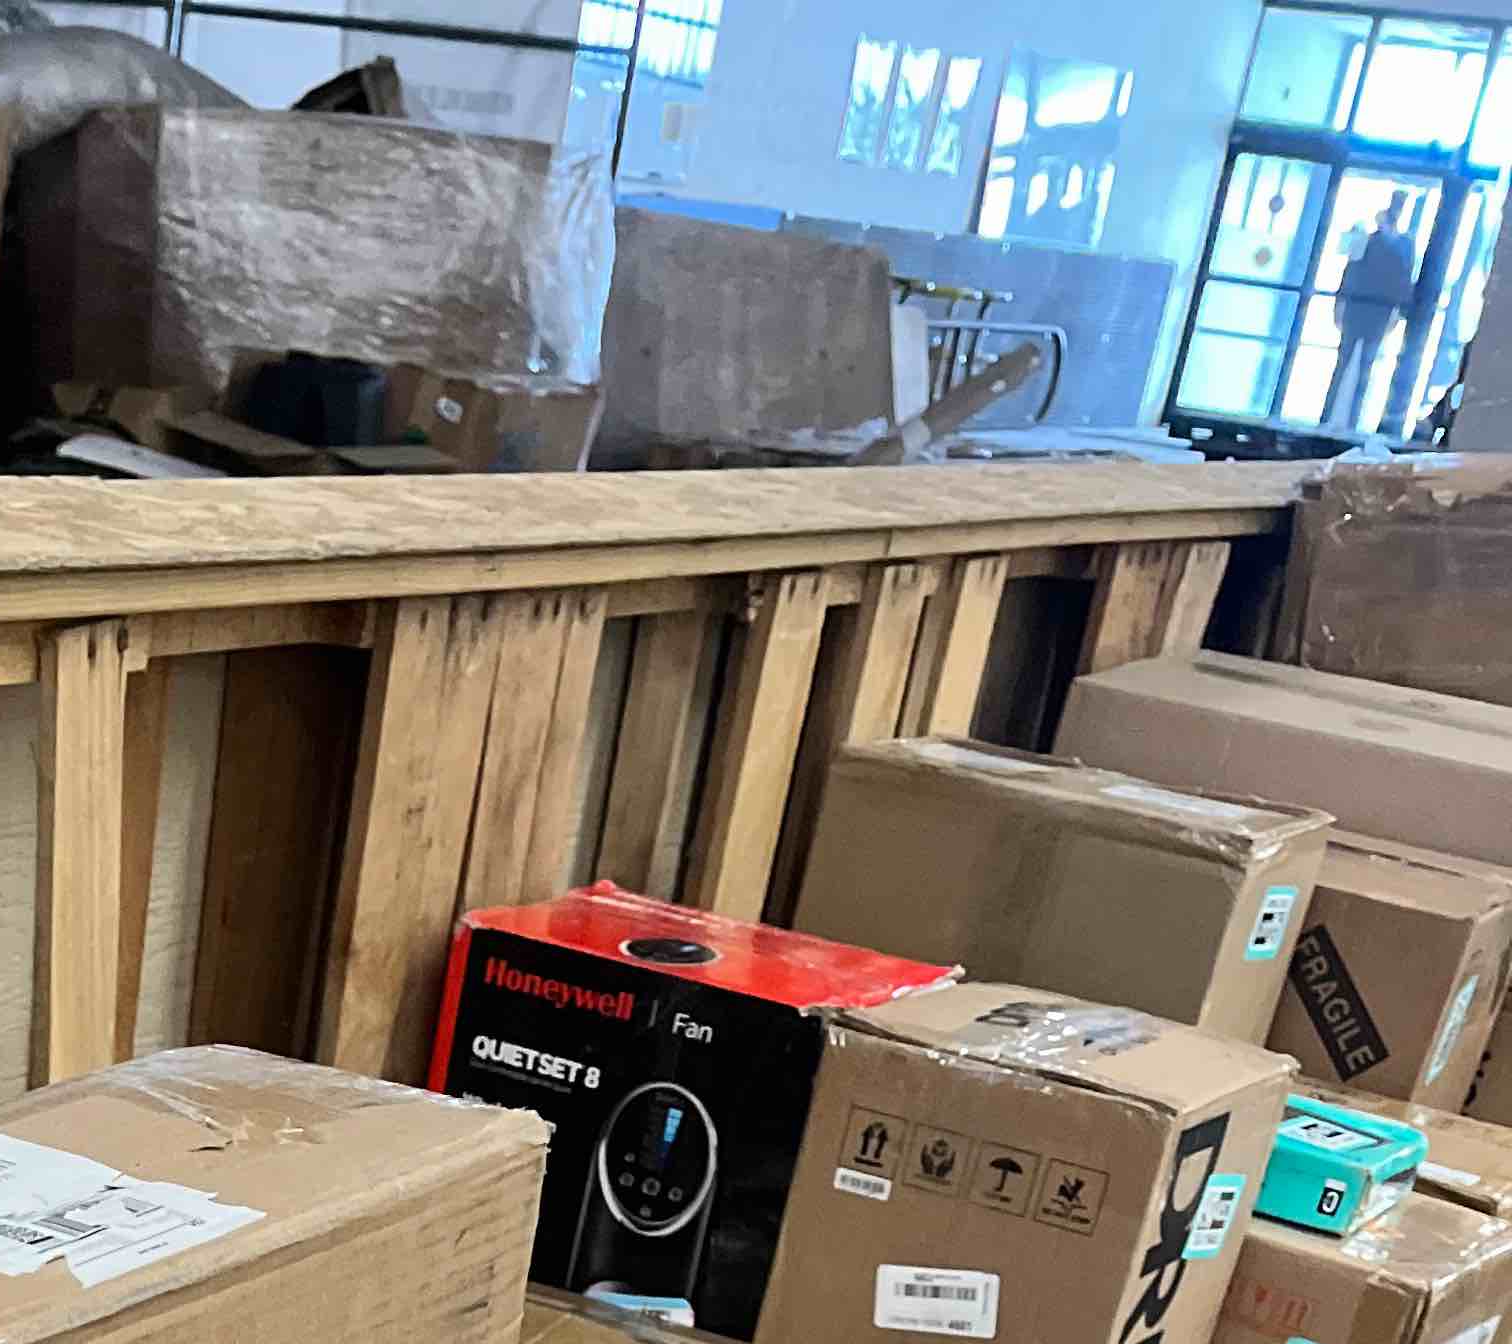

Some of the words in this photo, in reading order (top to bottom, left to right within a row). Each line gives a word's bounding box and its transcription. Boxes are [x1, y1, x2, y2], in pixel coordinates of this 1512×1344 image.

[484, 957, 634, 1021] Honeywell
[672, 1013, 713, 1044] Fan
[1297, 935, 1375, 1071] FRAGILE
[472, 1034, 582, 1083] QUIETSET
[584, 1067, 601, 1089] 8
